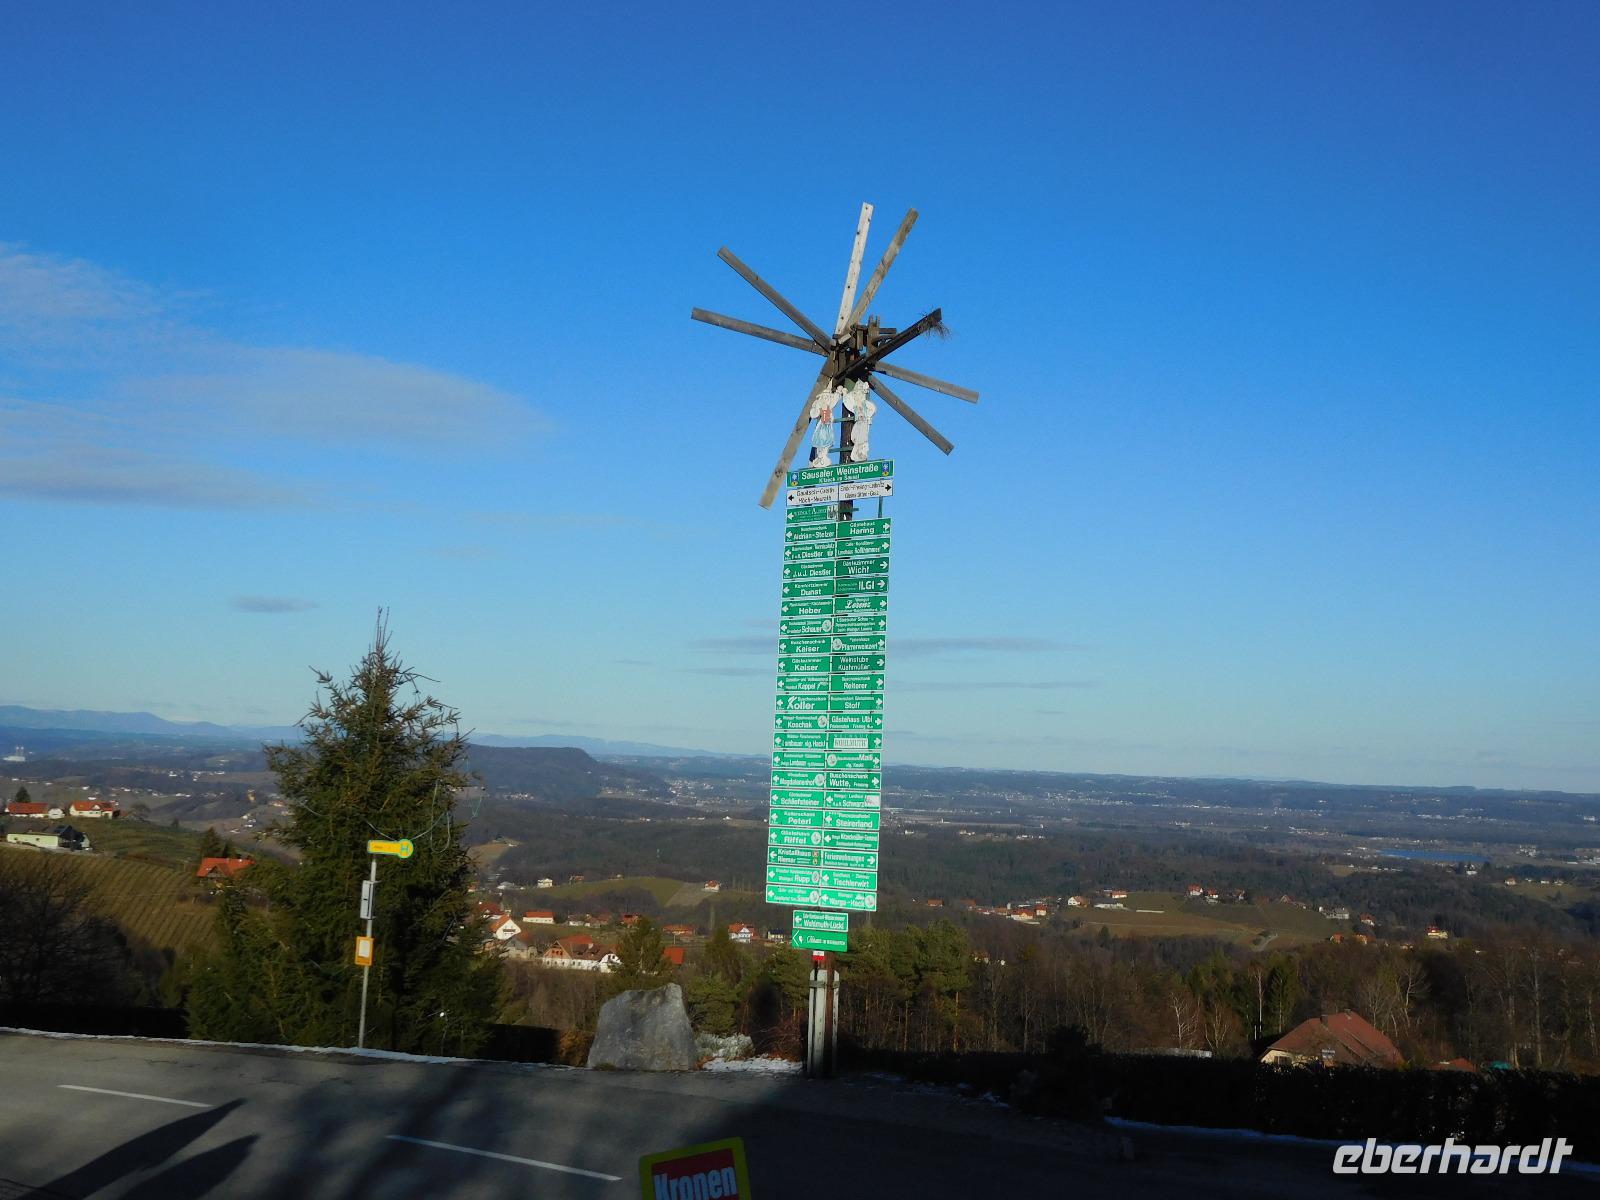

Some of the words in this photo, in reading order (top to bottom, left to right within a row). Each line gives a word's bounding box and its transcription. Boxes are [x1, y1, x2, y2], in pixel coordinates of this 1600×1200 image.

[801, 469, 834, 480] Sausaler
[836, 464, 879, 476] Weinstraße
[848, 566, 870, 574] Wicht
[859, 581, 874, 590] ILGI
[787, 696, 815, 709] Koller
[836, 819, 872, 828] Steirerland
[654, 1167, 737, 1200] Kronen
